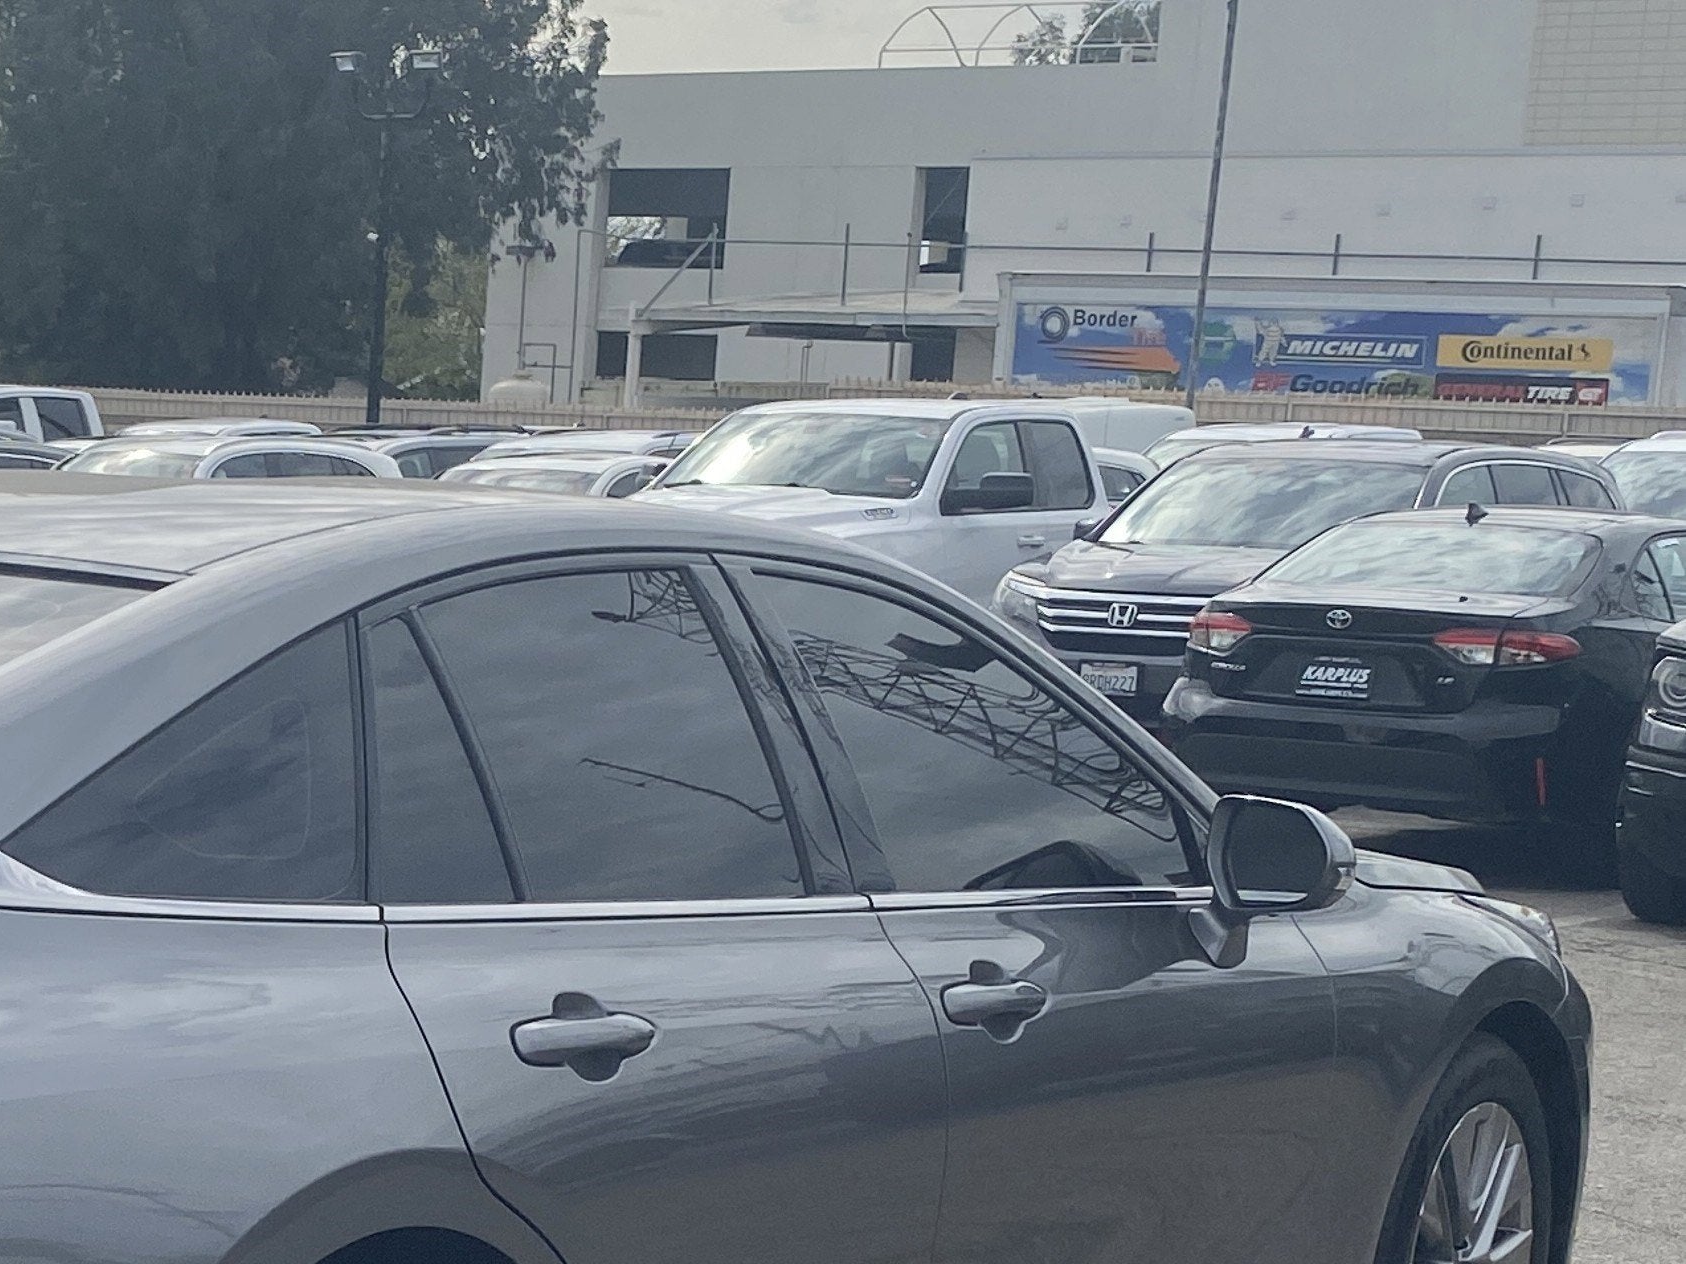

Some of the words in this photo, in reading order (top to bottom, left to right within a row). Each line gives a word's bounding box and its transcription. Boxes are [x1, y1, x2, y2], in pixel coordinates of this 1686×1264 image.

[1073, 309, 1137, 328] Border
[1287, 340, 1419, 358] MICHELIN
[1461, 340, 1574, 363] Continental
[1526, 385, 1574, 400] TIRE
[1301, 665, 1371, 683] KARPLUS
